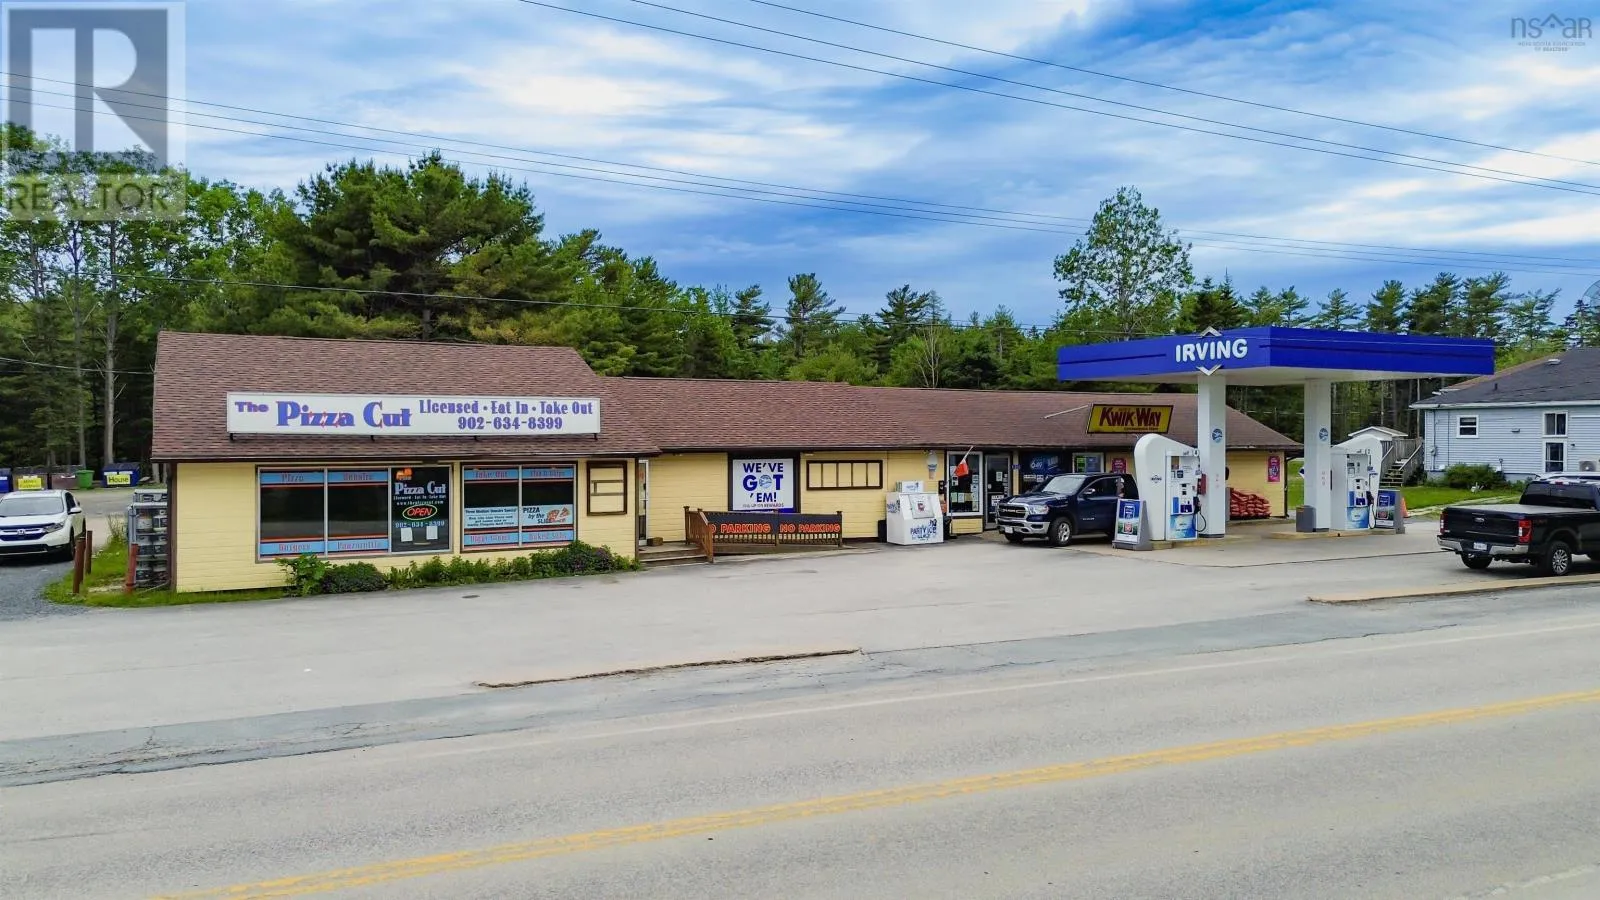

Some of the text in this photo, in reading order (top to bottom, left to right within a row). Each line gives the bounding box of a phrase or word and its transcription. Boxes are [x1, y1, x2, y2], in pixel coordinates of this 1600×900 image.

[1175, 338, 1248, 363] IRVING
[419, 399, 593, 415] Licensed Eat In Take Out
[235, 400, 412, 428] The Pizza Cut
[458, 416, 563, 431] 902-634-8399
[742, 462, 784, 473] WE'VE
[108, 475, 129, 484] House
[394, 480, 446, 495] Pizza Cut
[749, 491, 777, 502] 'EM!
[407, 507, 432, 517] OPEN
[720, 523, 771, 534] PARKING
[780, 523, 796, 533] NO
[798, 523, 841, 533] PARKING
